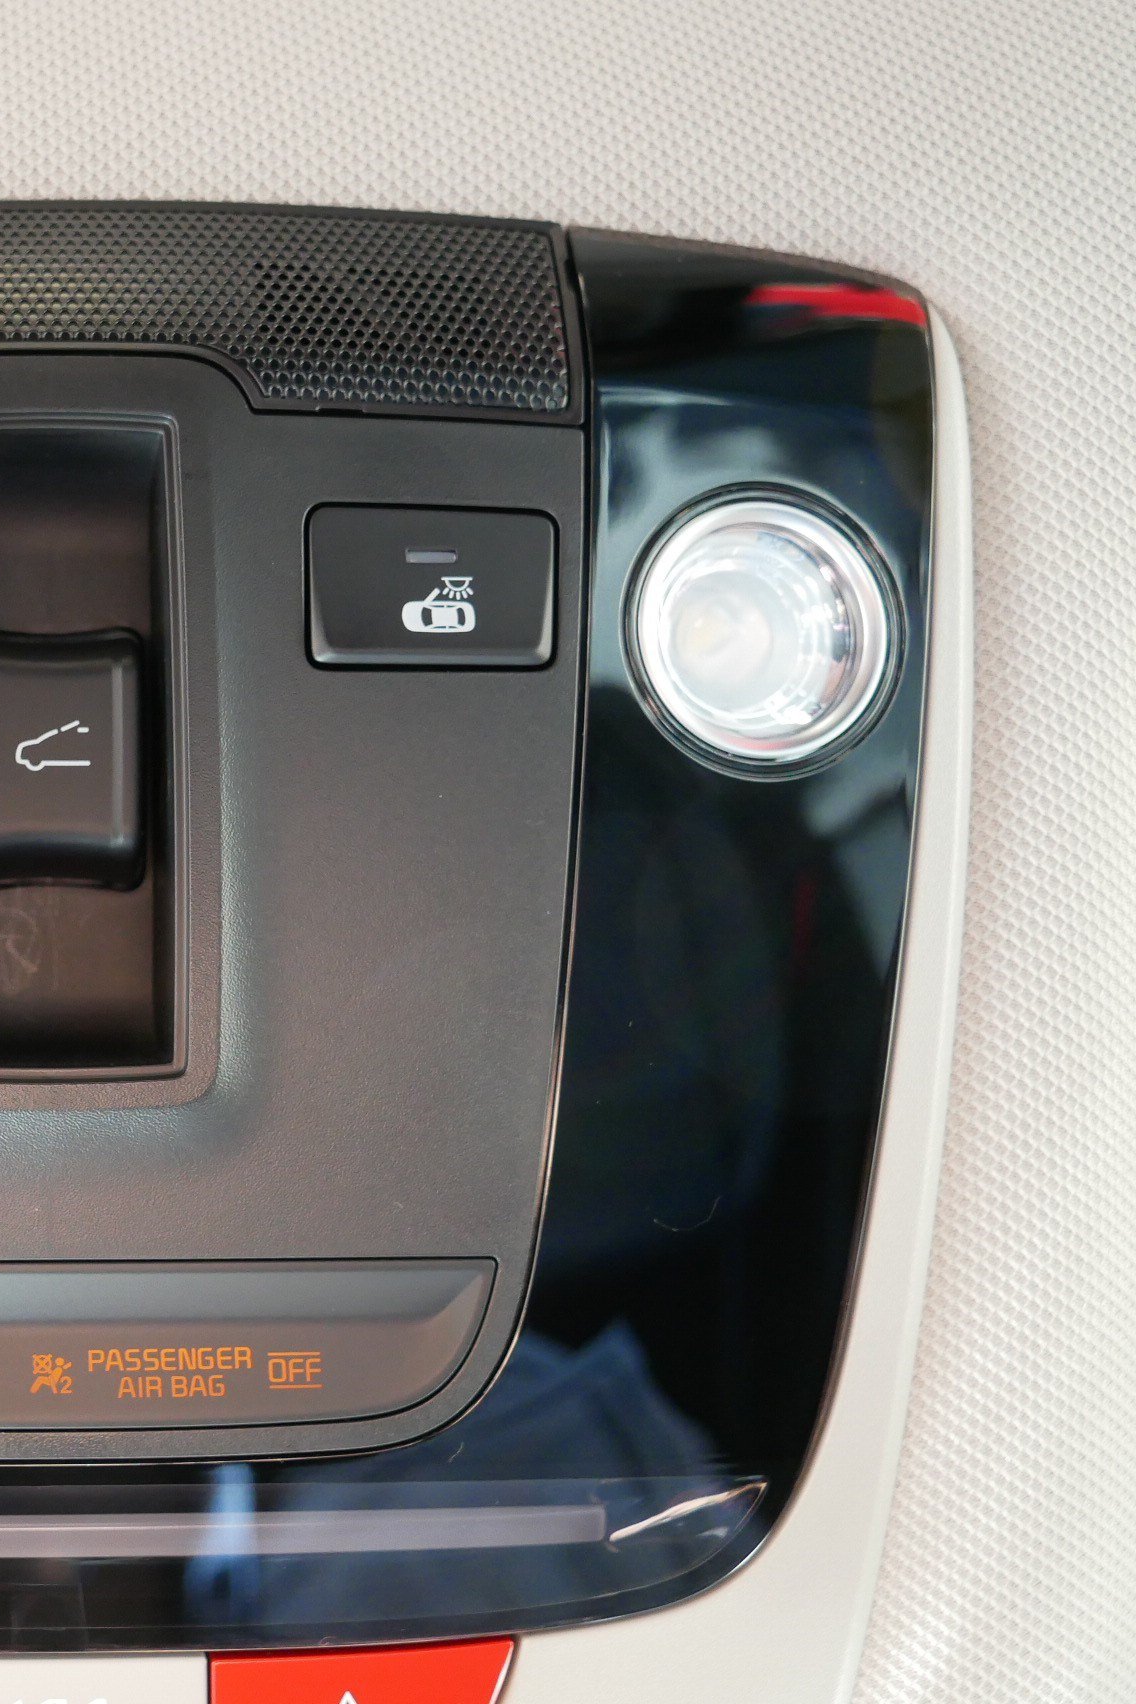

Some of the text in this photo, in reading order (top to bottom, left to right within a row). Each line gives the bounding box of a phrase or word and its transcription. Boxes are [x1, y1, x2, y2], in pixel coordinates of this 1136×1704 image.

[87, 1346, 254, 1372] PASSENGER
[268, 1358, 322, 1383] OFF
[60, 1376, 73, 1394] 2
[117, 1374, 227, 1399] AIR BAG
